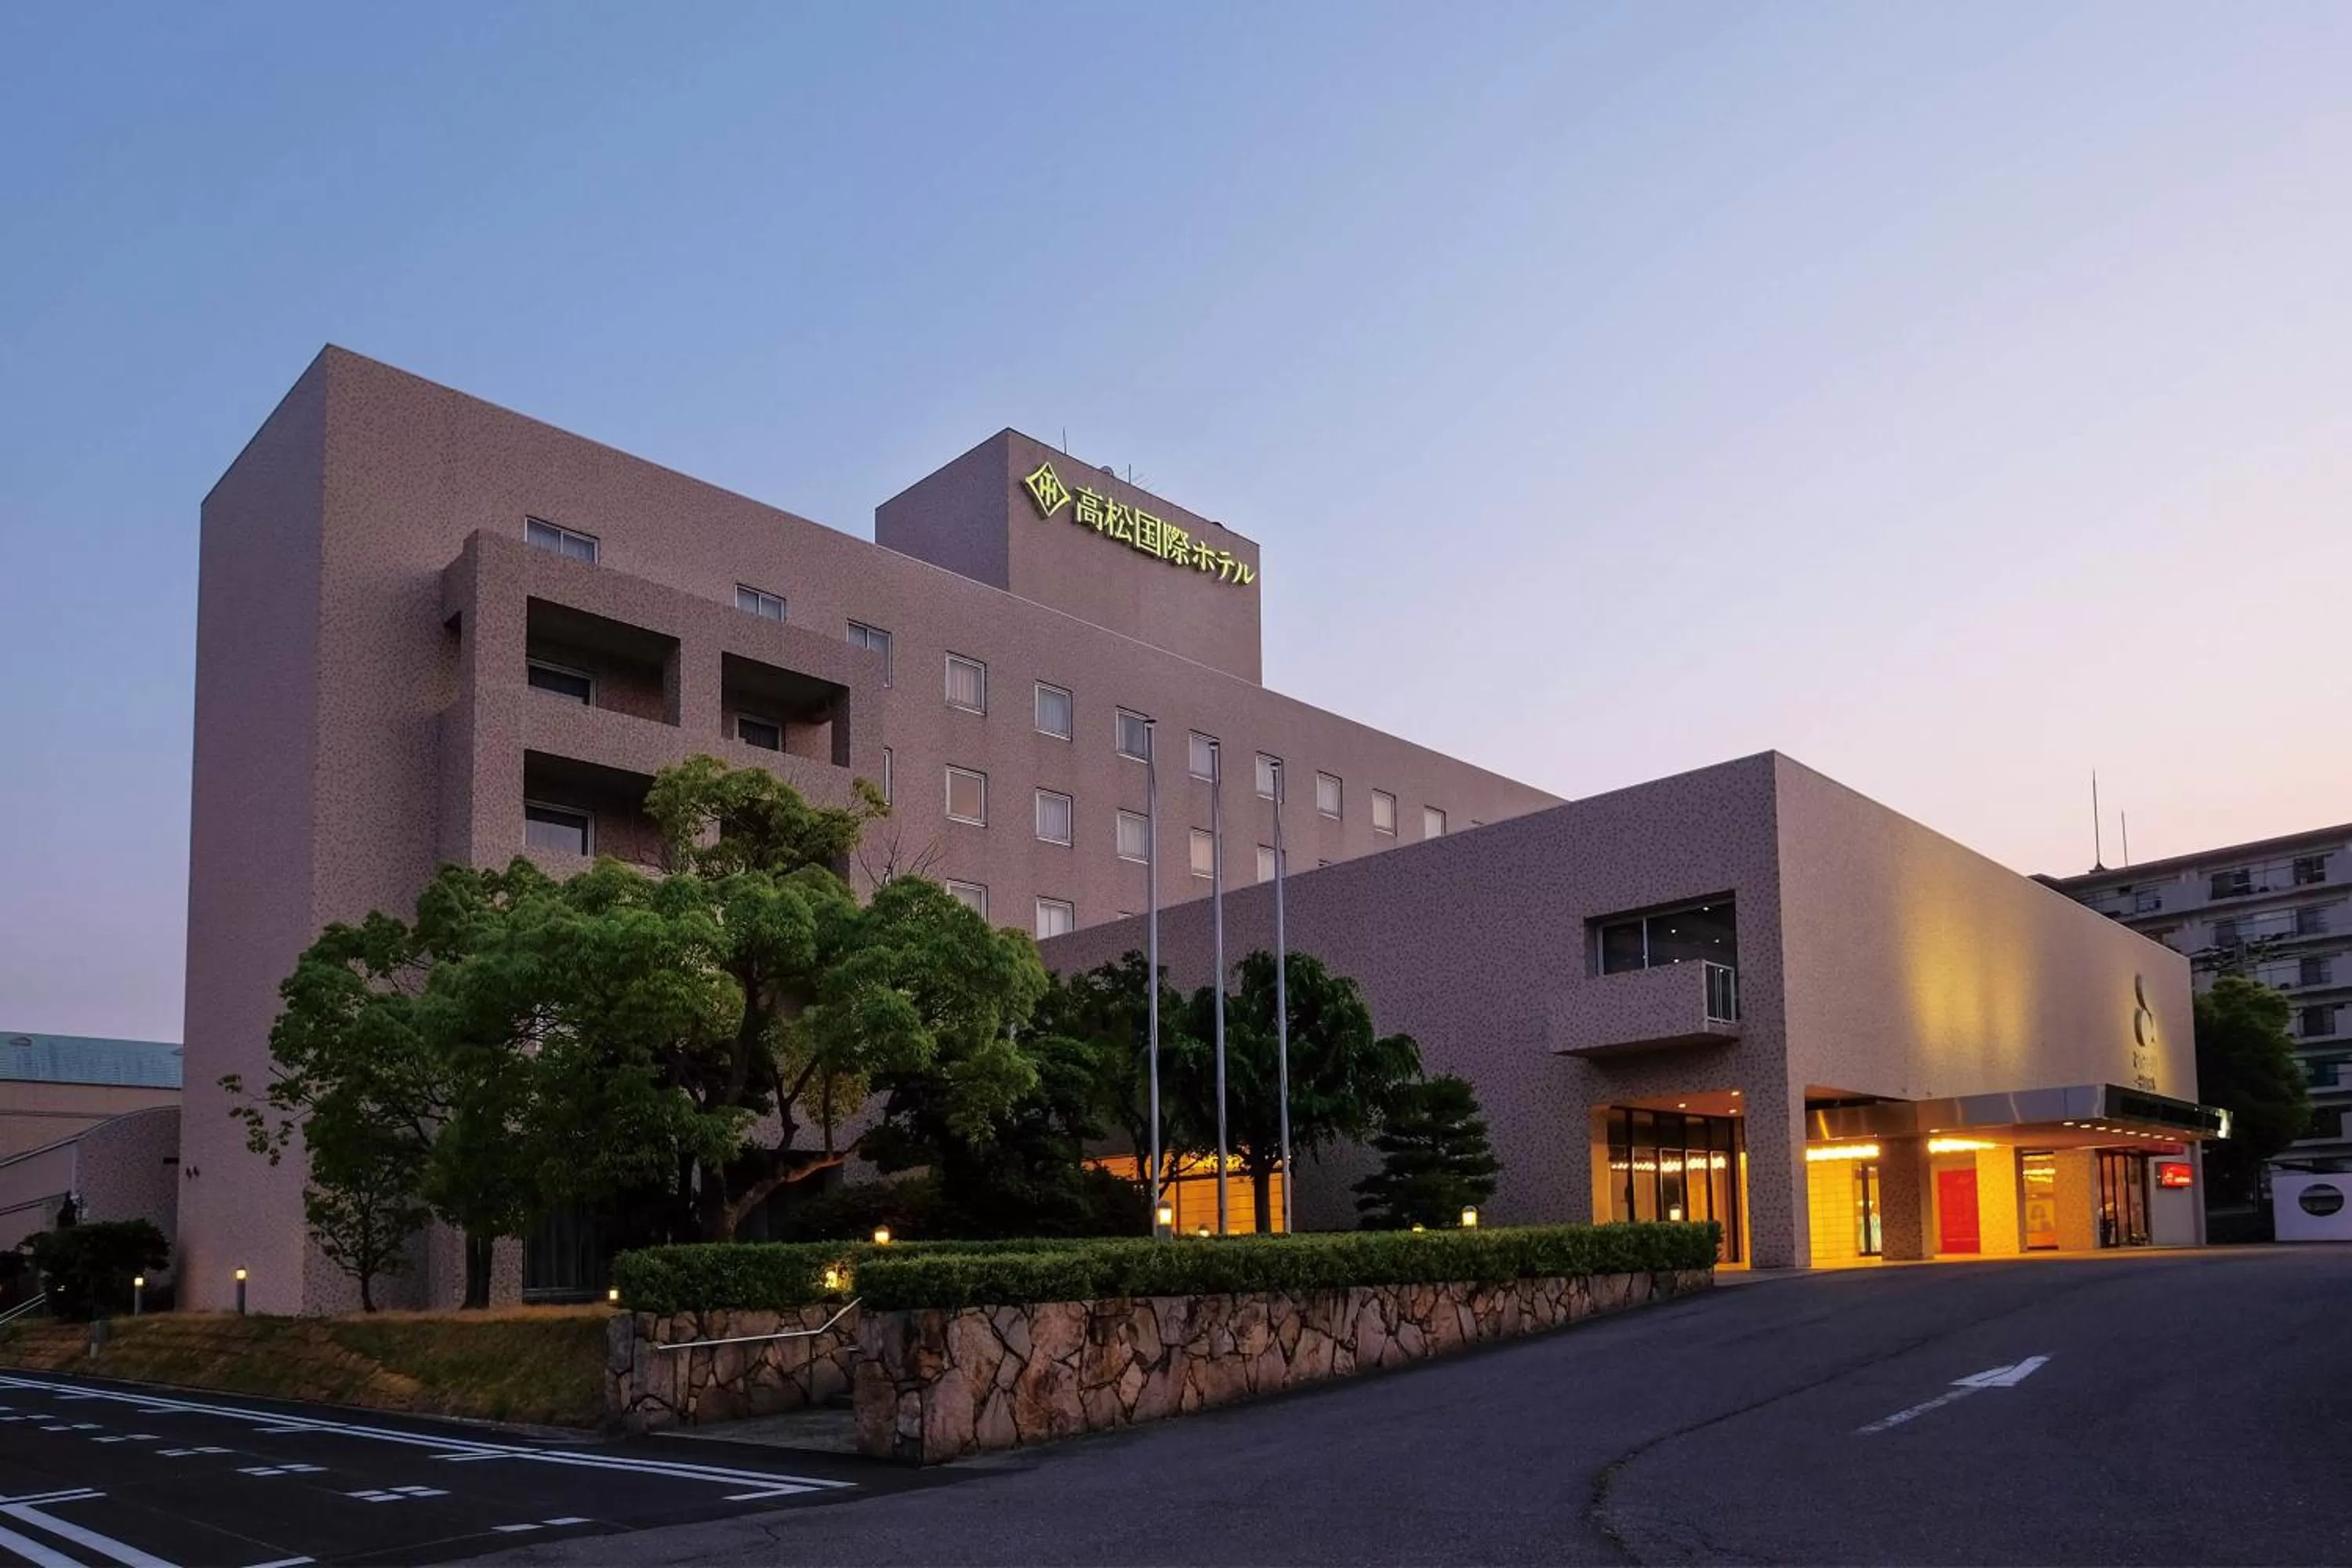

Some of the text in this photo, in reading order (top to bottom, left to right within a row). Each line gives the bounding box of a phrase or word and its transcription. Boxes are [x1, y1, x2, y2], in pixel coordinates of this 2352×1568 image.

[1076, 486, 1256, 584] 高松国際ホテル
